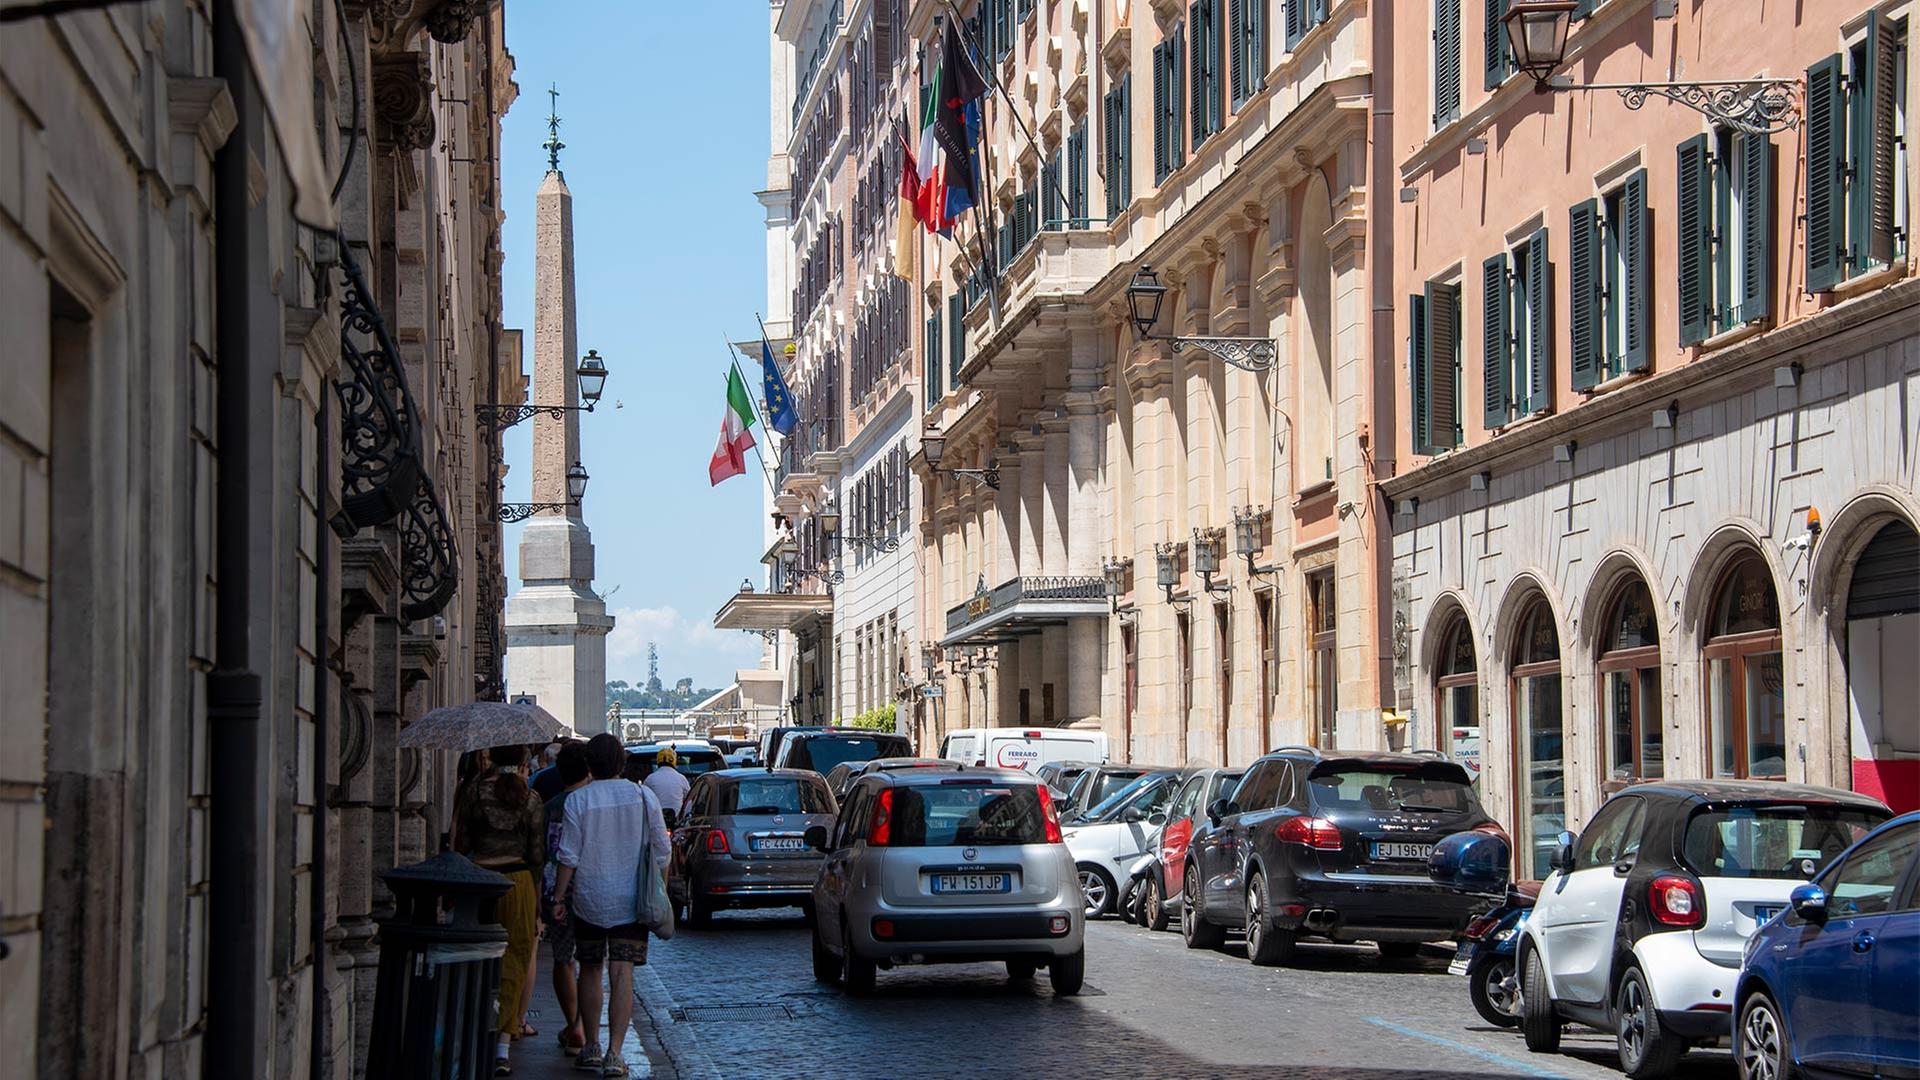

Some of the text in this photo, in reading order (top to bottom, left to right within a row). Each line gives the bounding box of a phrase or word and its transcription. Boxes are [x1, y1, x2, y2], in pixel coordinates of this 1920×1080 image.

[1378, 844, 1392, 856] EJ
[941, 876, 1002, 890] FW 151JP
